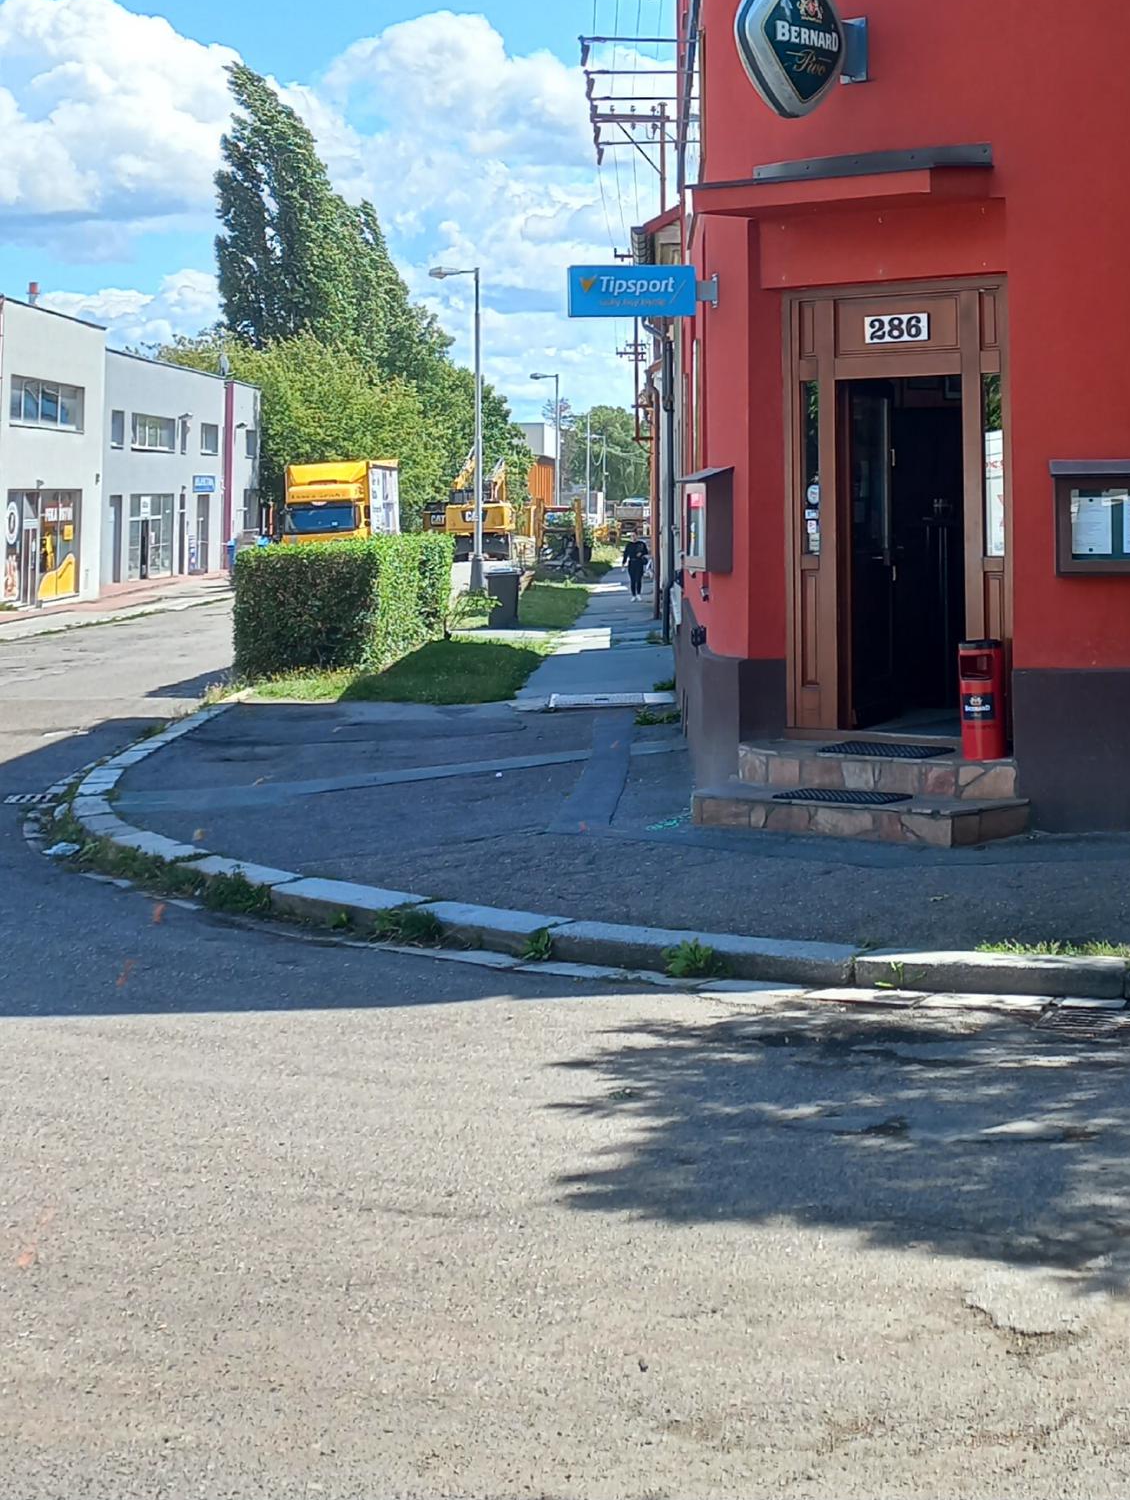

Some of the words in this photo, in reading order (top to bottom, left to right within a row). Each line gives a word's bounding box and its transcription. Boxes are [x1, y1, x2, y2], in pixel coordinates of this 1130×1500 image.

[775, 20, 840, 52] BERNARD
[600, 276, 675, 296] Tipsport
[869, 315, 922, 341] 286
[431, 514, 445, 525] CAT
